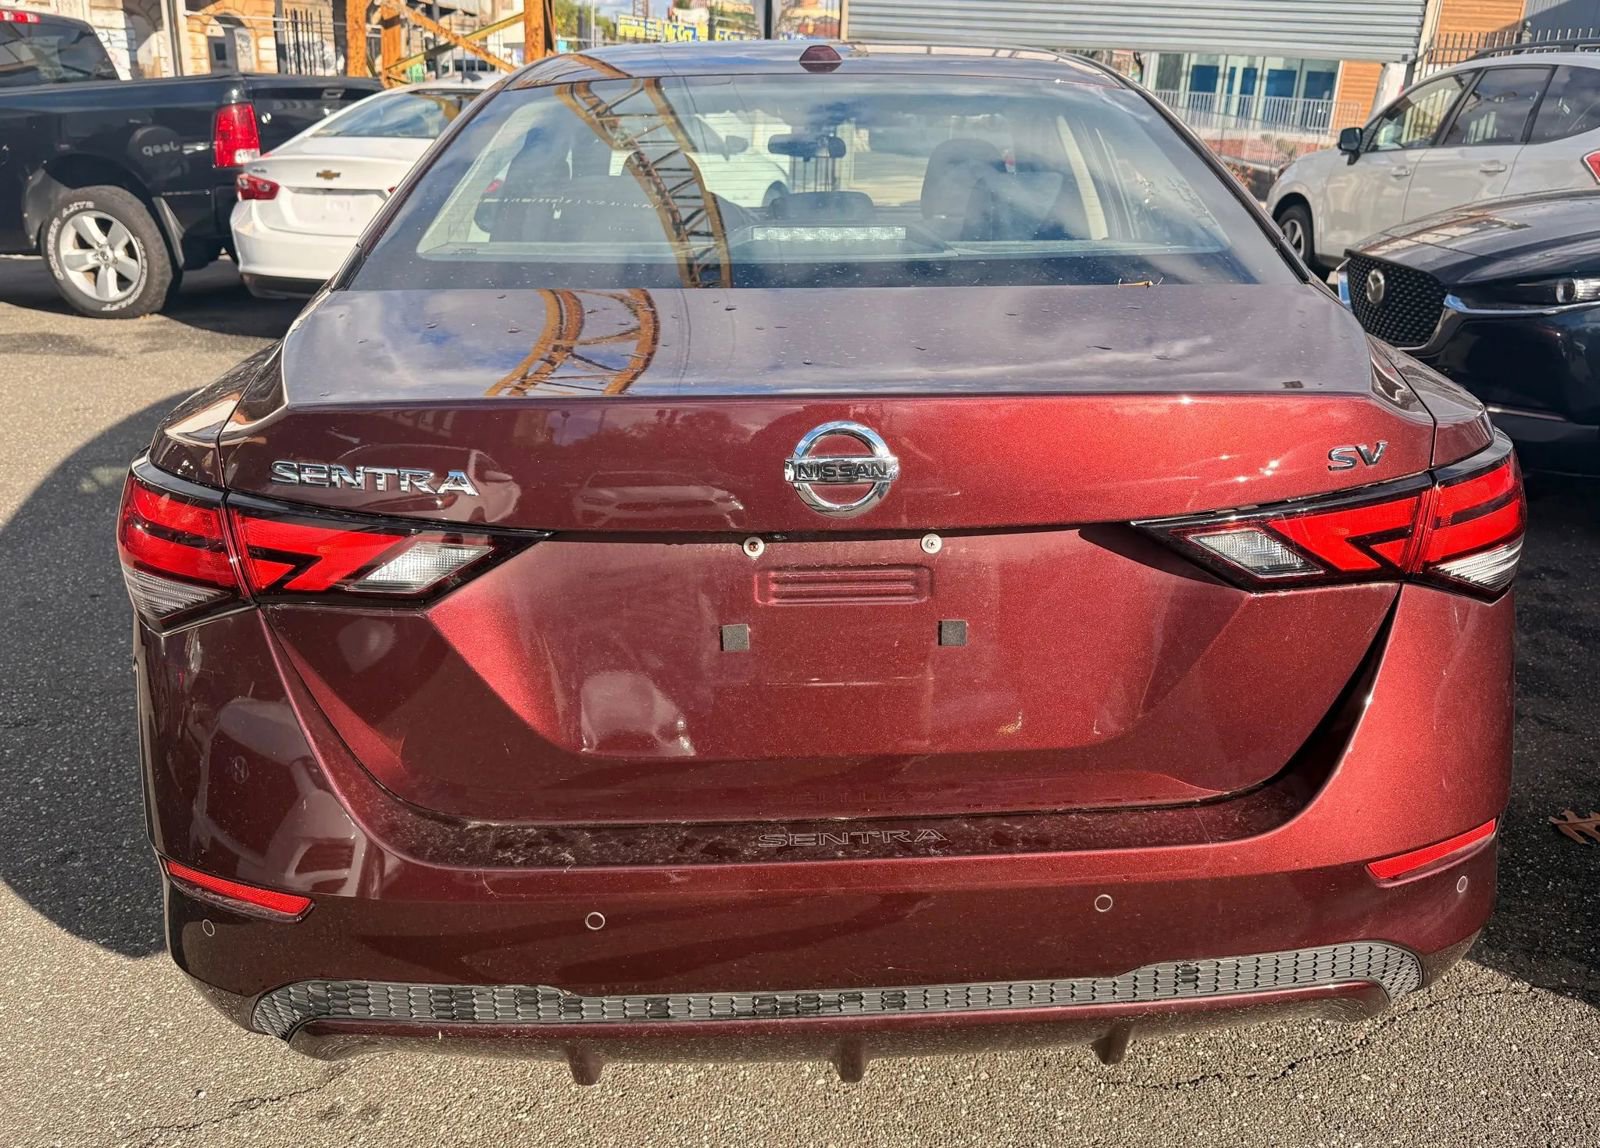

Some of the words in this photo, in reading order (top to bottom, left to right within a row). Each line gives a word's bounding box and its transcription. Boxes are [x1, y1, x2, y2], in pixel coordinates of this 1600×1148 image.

[1327, 439, 1388, 471] SV
[270, 459, 480, 497] SENTRA
[797, 462, 887, 478] NISSAN
[758, 828, 949, 848] SENTRA
